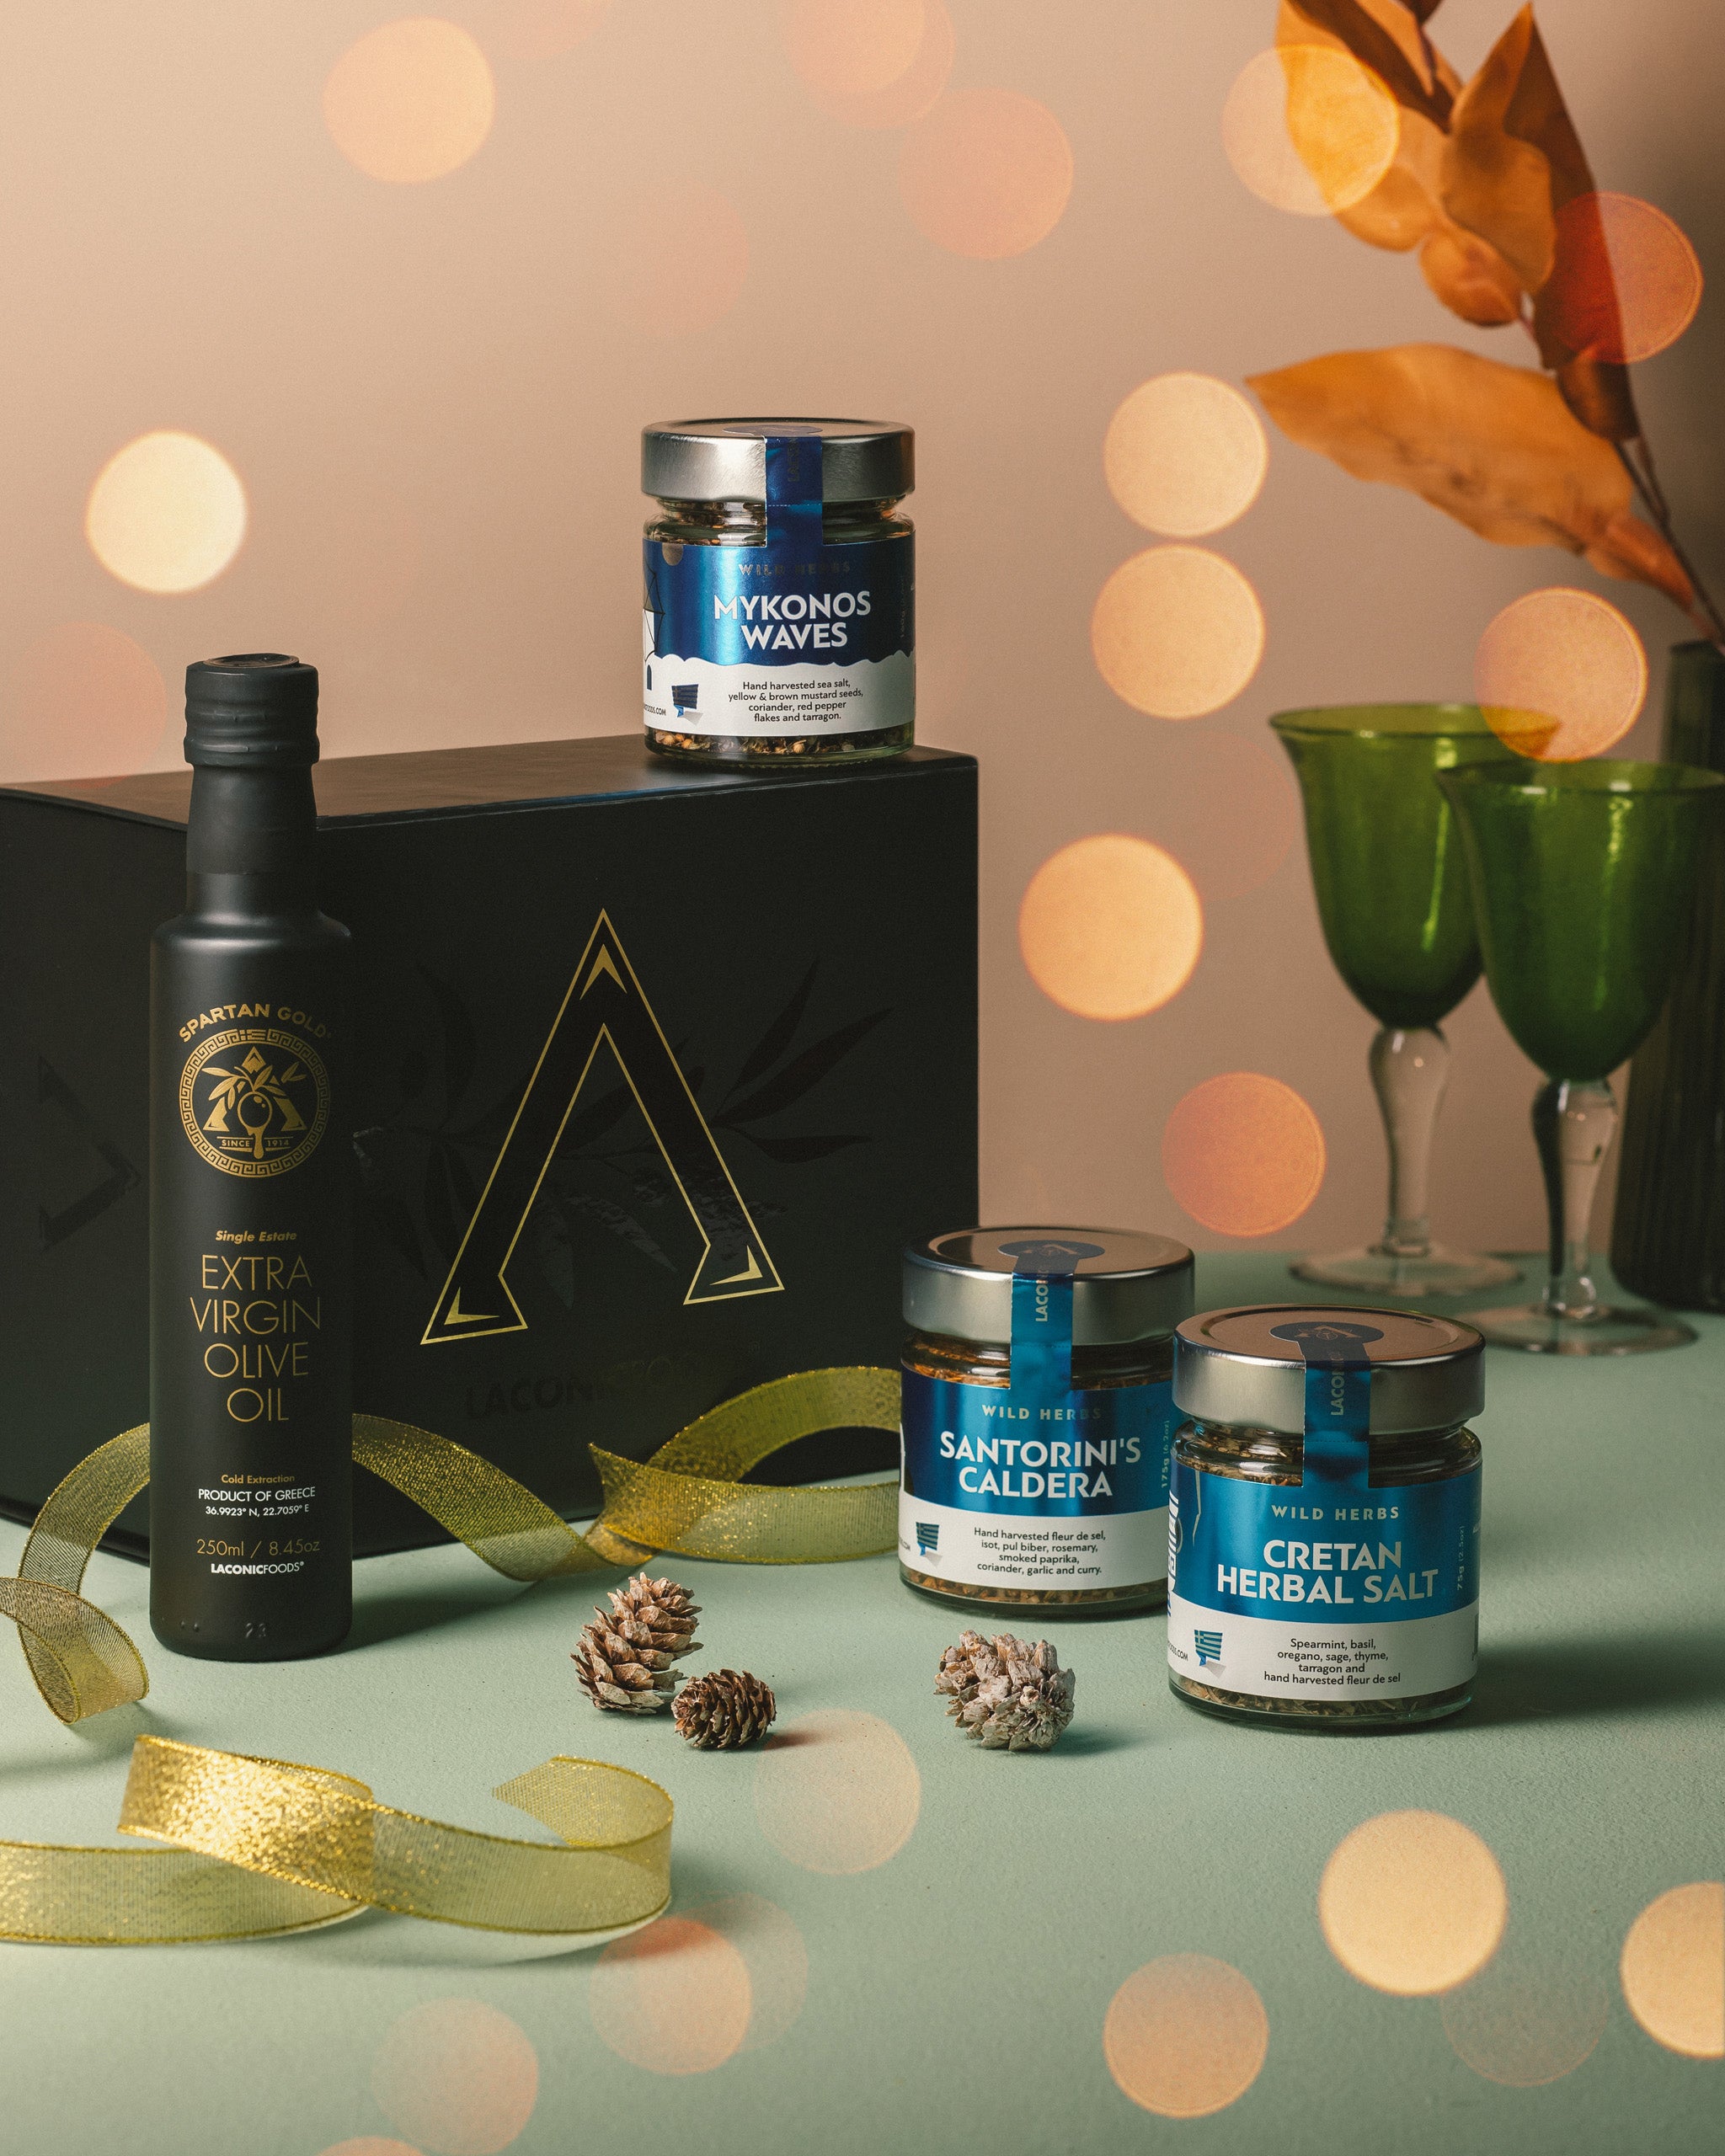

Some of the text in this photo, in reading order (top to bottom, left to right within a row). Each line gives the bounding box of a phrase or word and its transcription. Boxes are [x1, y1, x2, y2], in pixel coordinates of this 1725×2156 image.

[738, 563, 785, 575] WILD
[713, 590, 871, 621] MYKONOS
[740, 622, 848, 650] WAVES
[743, 681, 767, 690] Hand
[770, 680, 815, 690] harvested
[834, 678, 851, 688] salt,
[728, 688, 863, 702] yellow & brown mustard seeds,
[748, 702, 846, 712] coriander, red pepper
[754, 712, 841, 722] flakes and tarragon.
[179, 1003, 270, 1043] SPARTAN
[215, 1230, 296, 1245] Single Estate
[202, 1254, 312, 1291] EXTRA
[190, 1296, 321, 1335] VIRGIN
[204, 1342, 308, 1379] OLIVE
[227, 1387, 289, 1422] OIL
[981, 1404, 1103, 1421] WILD HERBS
[939, 1431, 1141, 1467] SANTORINI'S
[221, 1475, 295, 1484] Cold Extraction
[1160, 1457, 1170, 1489] 175g
[959, 1466, 1113, 1498] CALDERA
[198, 1486, 316, 1502] PRODUCT OF GREECE
[248, 1508, 260, 1517] N,
[304, 1504, 309, 1513] E
[1271, 1505, 1399, 1521] WILD HERBS
[974, 1527, 1106, 1540] Hand harvested fleur de sel,
[196, 1538, 320, 1559] 250ml / 8.45oz
[981, 1540, 1098, 1553] isot, pul biber, rosemary,
[999, 1553, 1079, 1566] smoked paprika,
[1263, 1540, 1402, 1571] CRETAN
[977, 1562, 1102, 1576] coriander, garlic and curry.
[1217, 1564, 1439, 1604] HERBAL SALT
[1456, 1565, 1465, 1591] 75g
[1290, 1638, 1376, 1651] Spearmint, basil,
[1277, 1651, 1389, 1663] oregano, sage, thyme,
[1298, 1663, 1365, 1675] tarragon and
[1264, 1671, 1401, 1684] hand harvested fleur de sel
